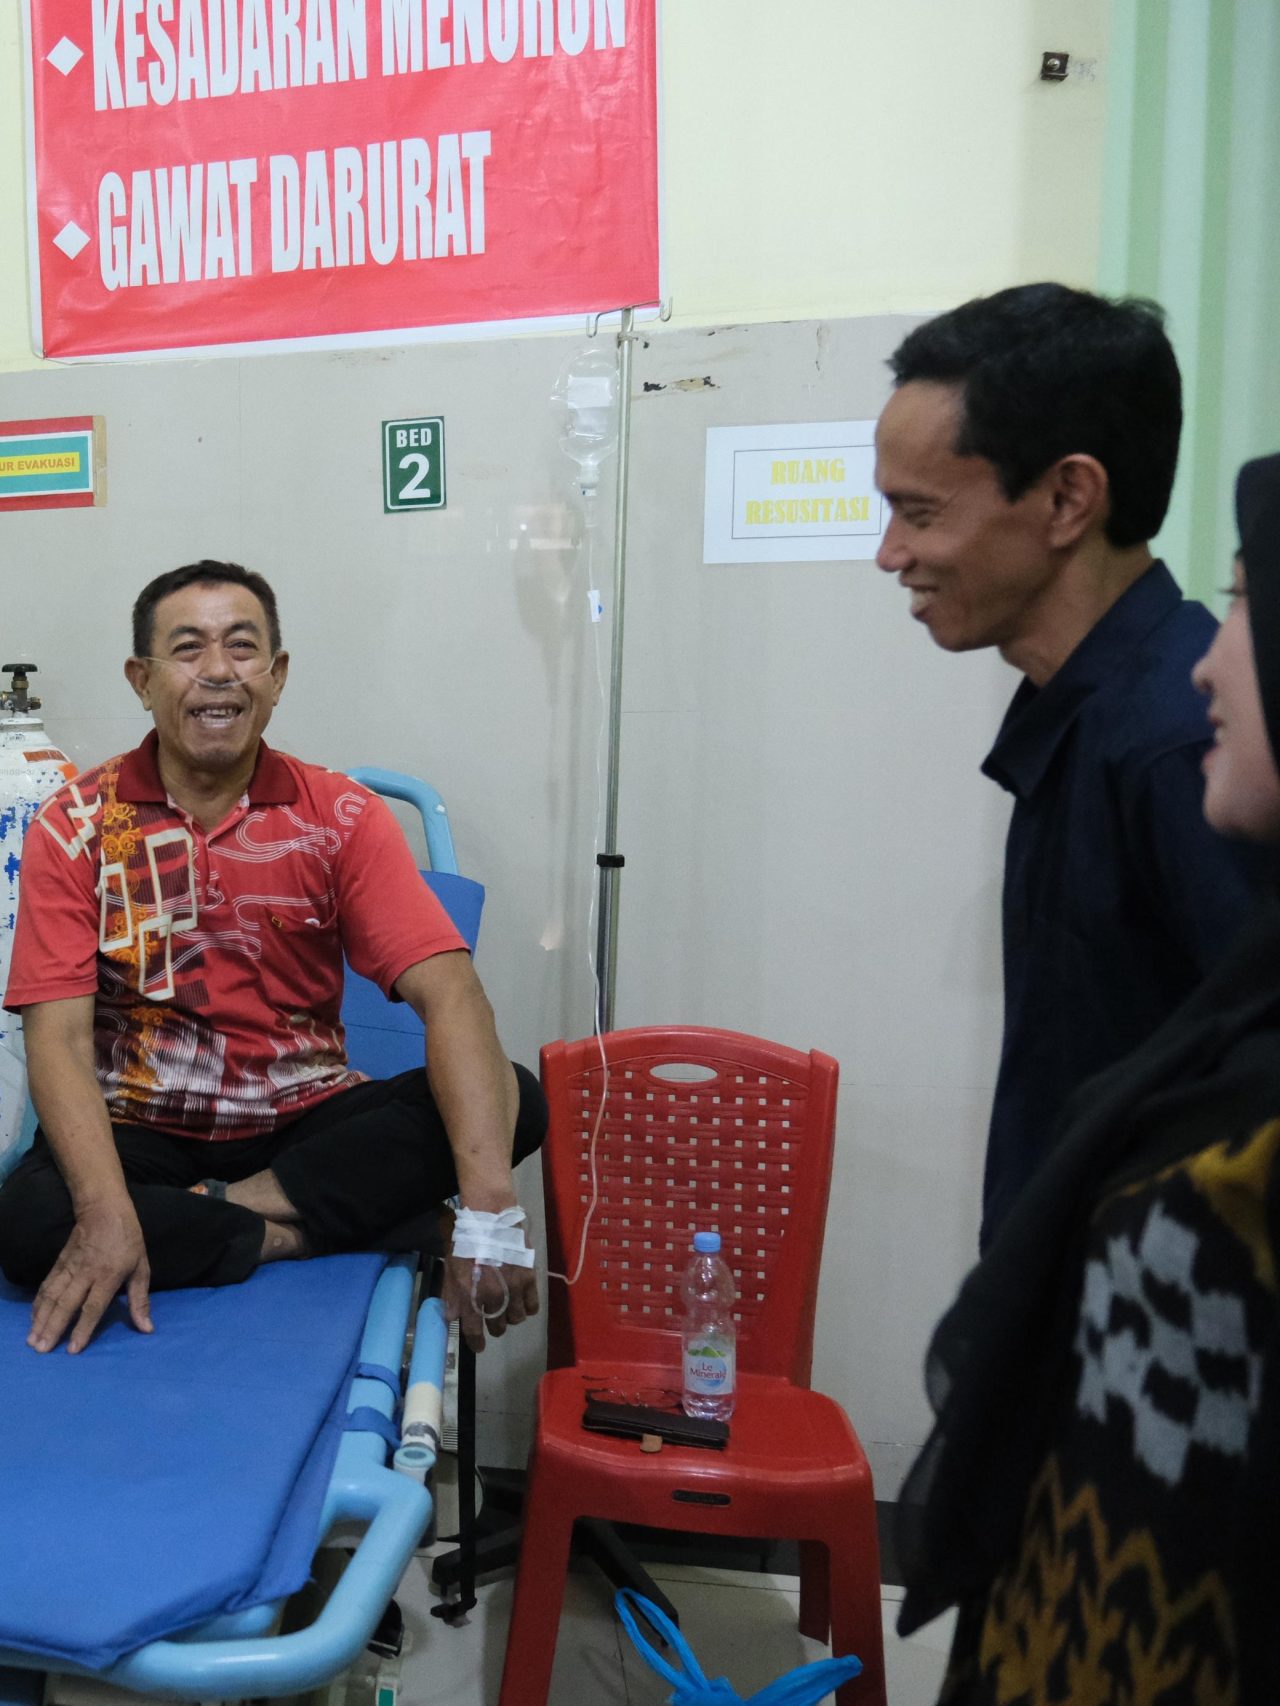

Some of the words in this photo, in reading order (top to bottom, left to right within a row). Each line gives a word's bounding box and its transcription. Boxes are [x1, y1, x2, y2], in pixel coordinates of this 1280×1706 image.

[91, 0, 368, 111] KESADARAN
[98, 159, 257, 291] GAWAT
[270, 131, 491, 273] DARURAT
[396, 428, 432, 448] BED
[18, 457, 75, 470] EVAKUASI
[399, 453, 431, 500] 2
[771, 459, 845, 485] RUANG
[745, 496, 869, 525] RESUSITASI
[702, 1362, 713, 1371] Le
